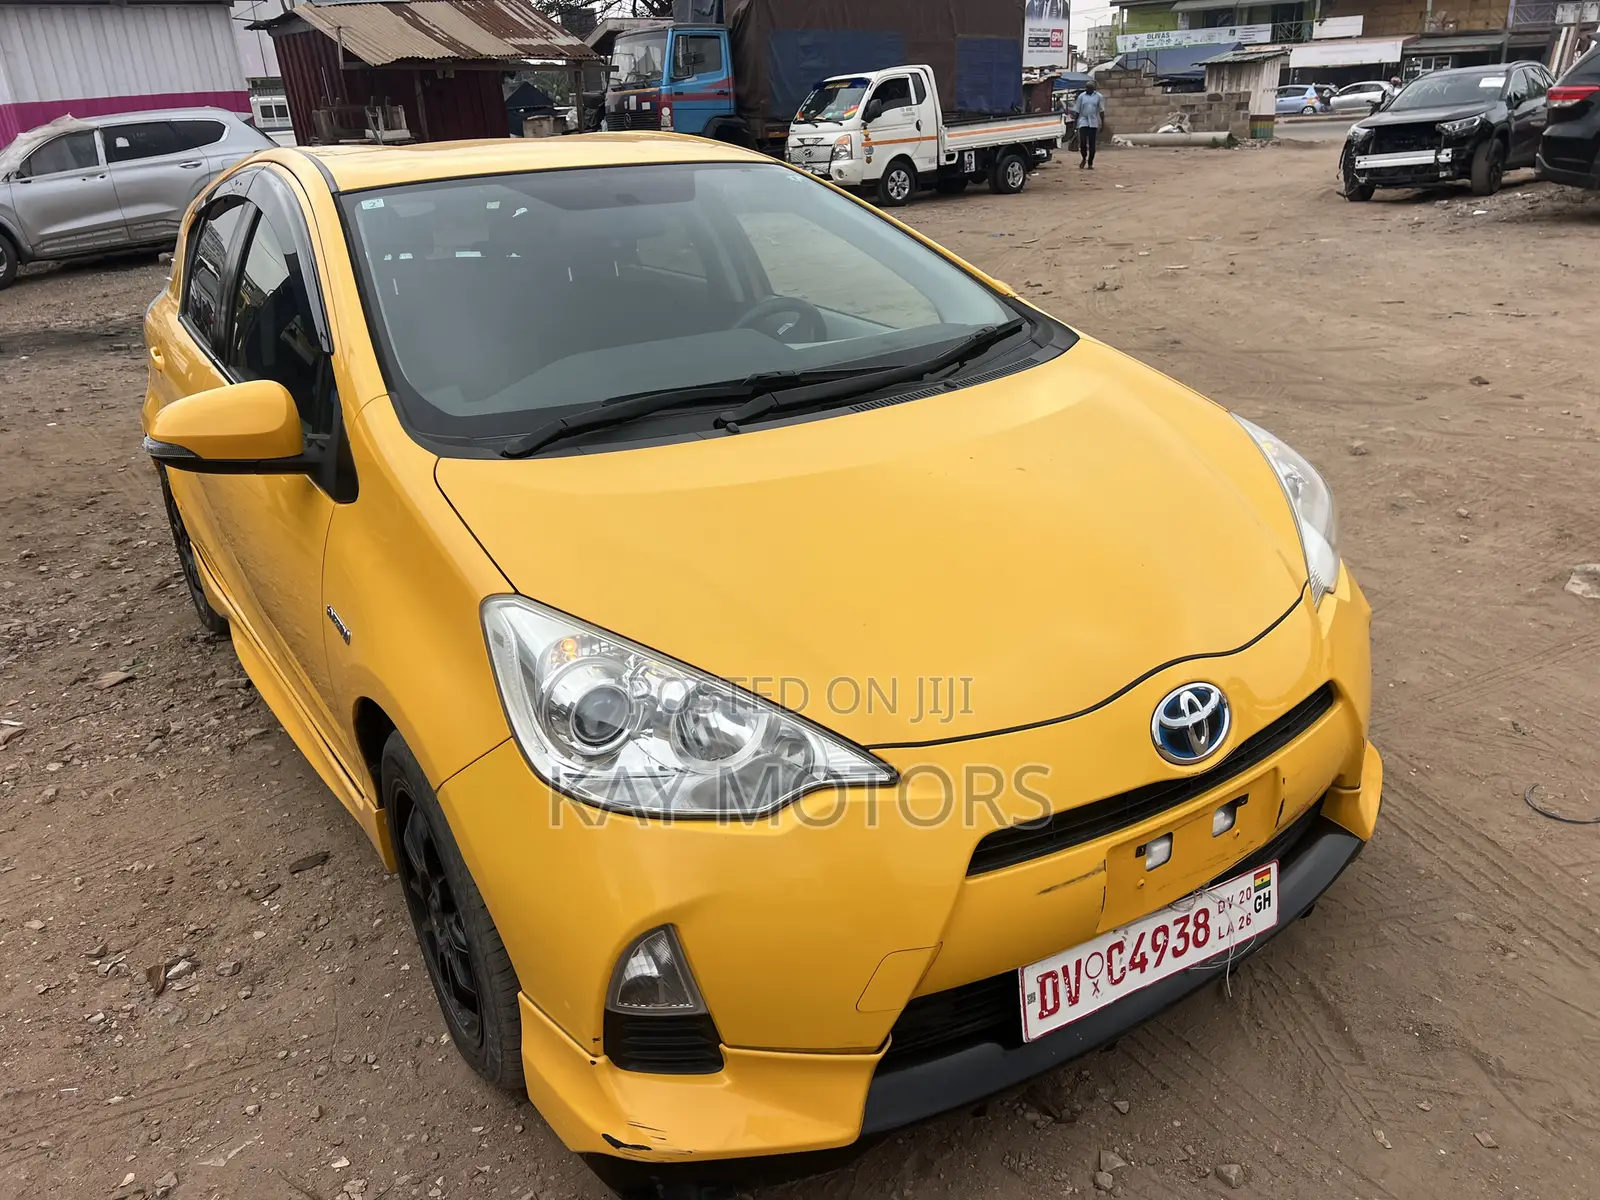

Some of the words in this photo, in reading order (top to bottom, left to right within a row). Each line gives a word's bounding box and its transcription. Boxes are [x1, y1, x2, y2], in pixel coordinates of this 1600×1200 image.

[1146, 32, 1170, 40] OLIVAS
[1217, 894, 1235, 915] DV
[1239, 886, 1252, 905] 20
[1253, 889, 1272, 914] GH
[1036, 957, 1083, 1020] DV
[1106, 907, 1210, 986] C4938
